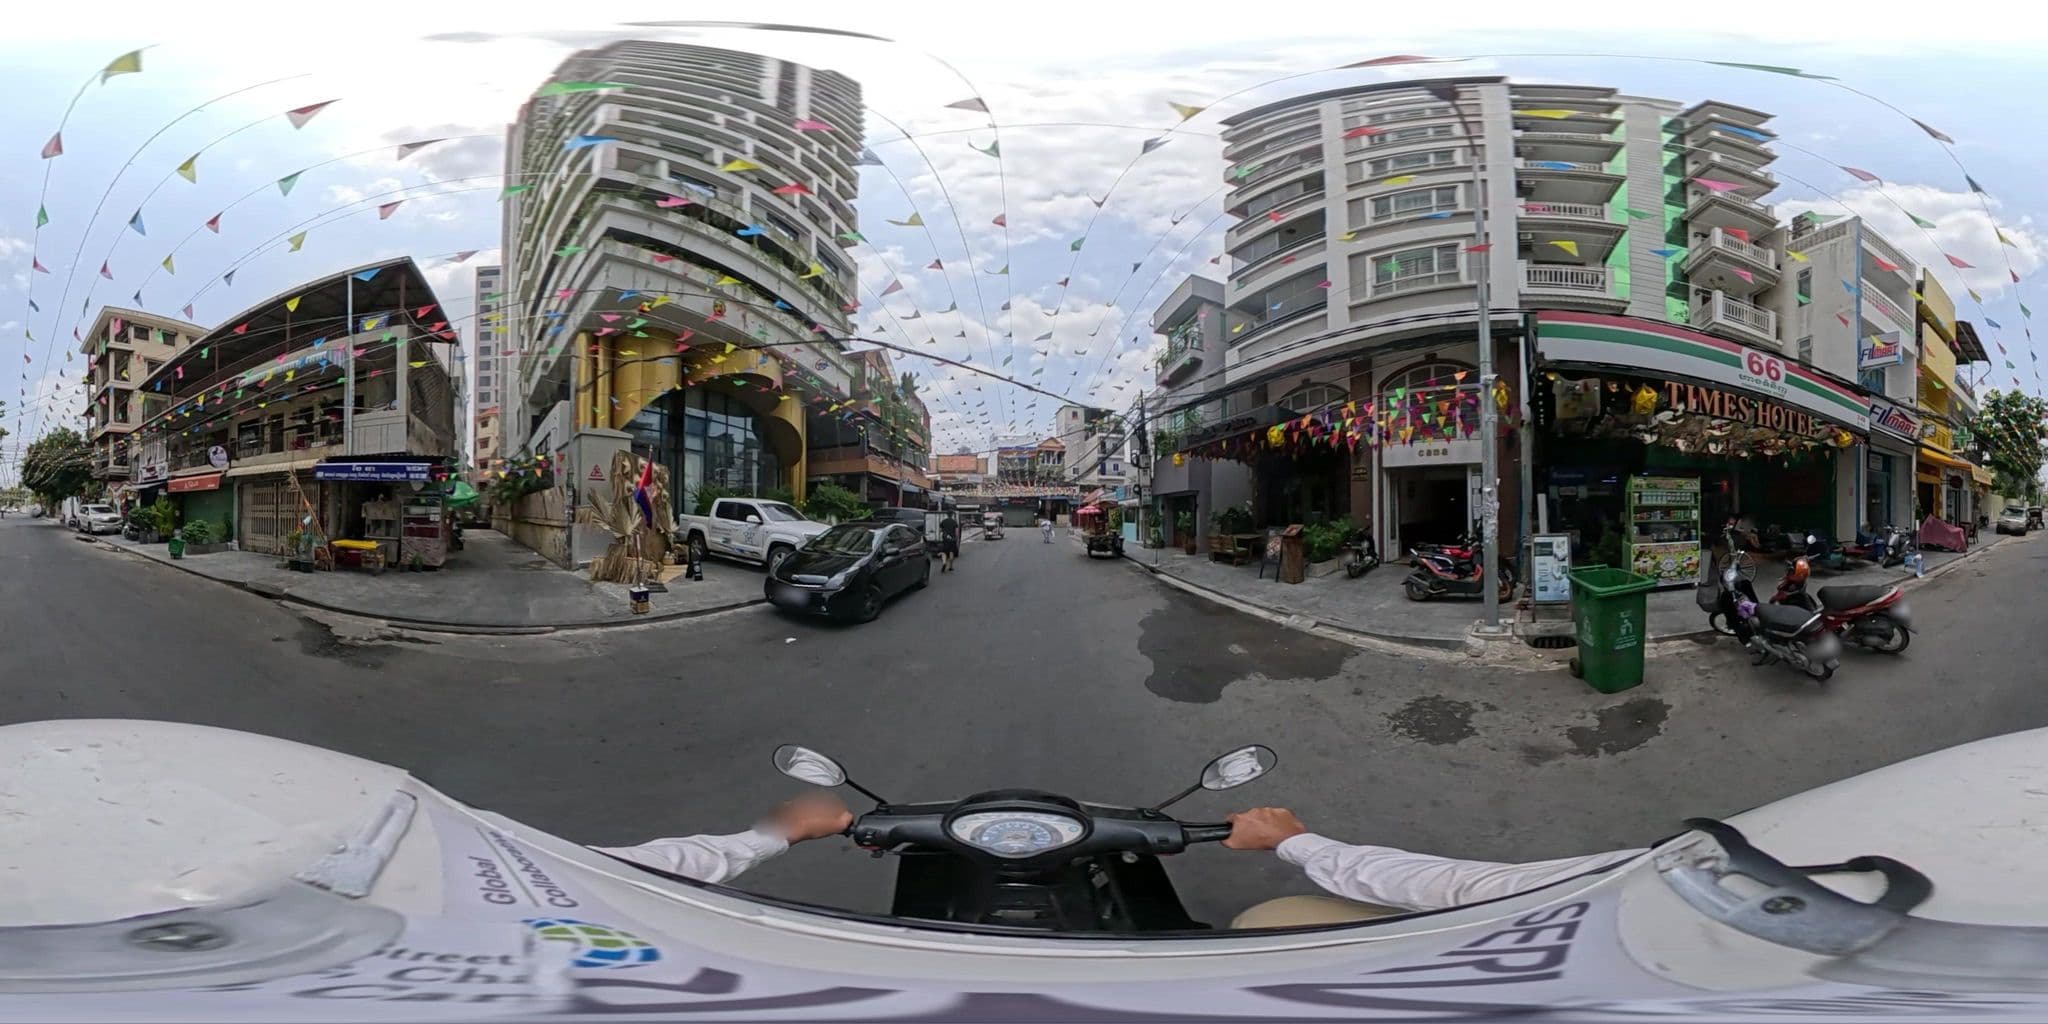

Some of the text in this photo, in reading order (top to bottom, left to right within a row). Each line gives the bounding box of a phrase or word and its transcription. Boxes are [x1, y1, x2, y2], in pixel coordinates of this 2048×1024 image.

[1747, 351, 1781, 381] 66
[1664, 380, 1817, 437] TIMES HOTEL
[467, 855, 518, 905] Global
